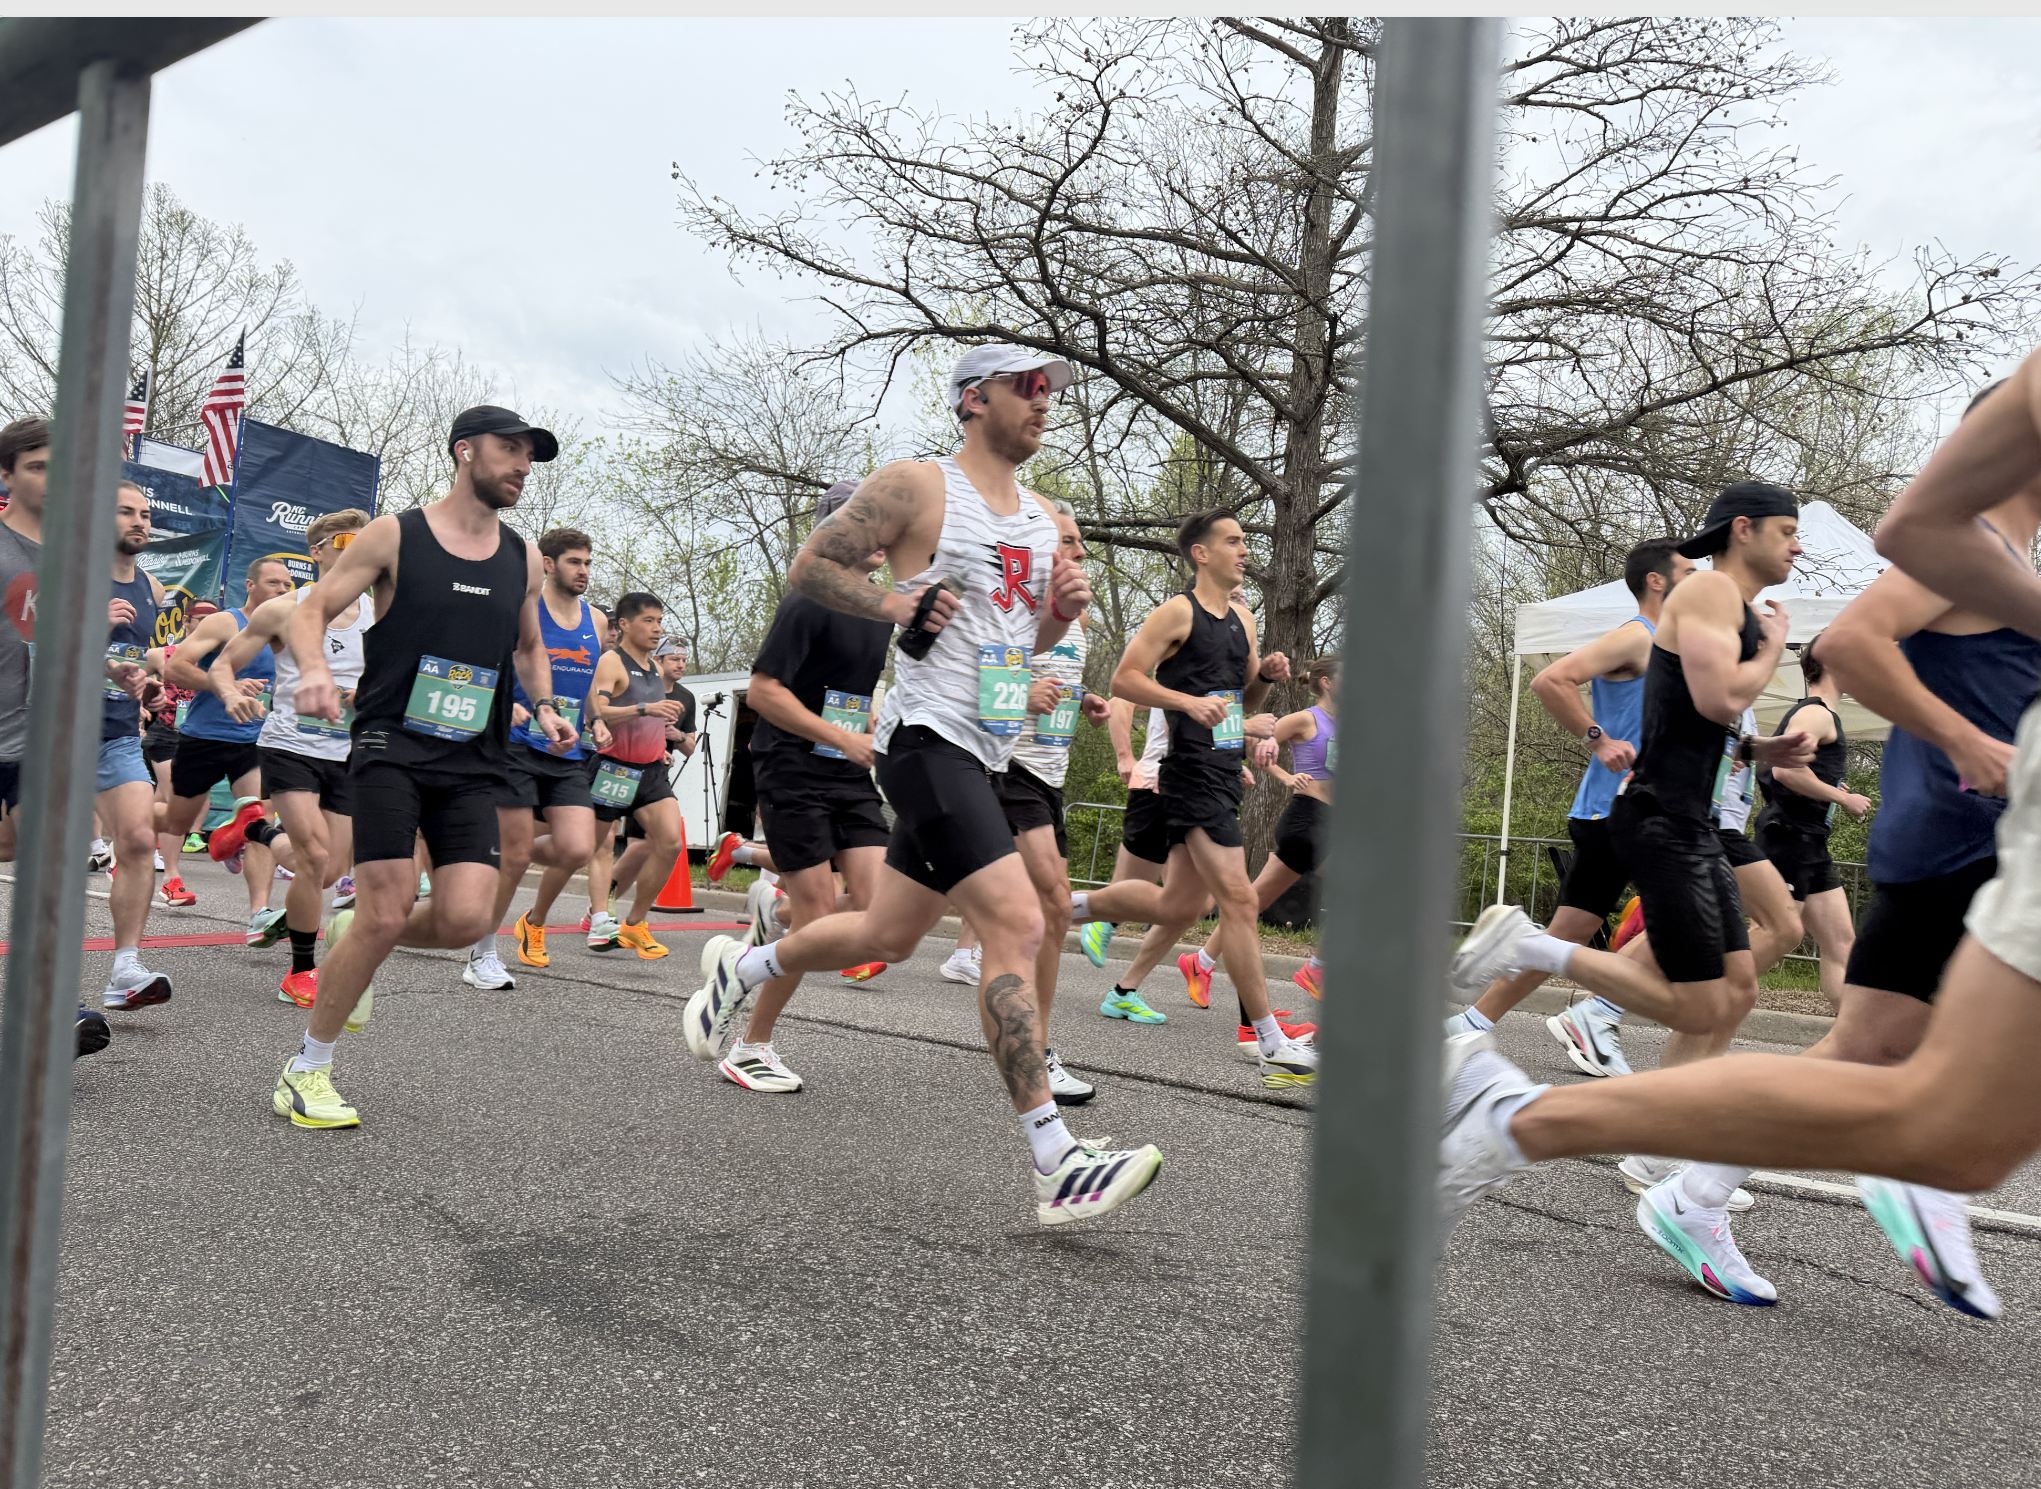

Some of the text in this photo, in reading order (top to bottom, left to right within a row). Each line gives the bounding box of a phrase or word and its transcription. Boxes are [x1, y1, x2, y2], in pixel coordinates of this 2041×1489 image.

[291, 505, 307, 515] KC
[288, 560, 306, 571] BURNS
[422, 663, 440, 675] AA
[551, 664, 594, 675] ENDURANCE
[827, 696, 840, 706] AA
[993, 681, 1028, 711] 226
[427, 690, 478, 722] 195
[1049, 709, 1074, 730] 197
[599, 780, 630, 799] 215
